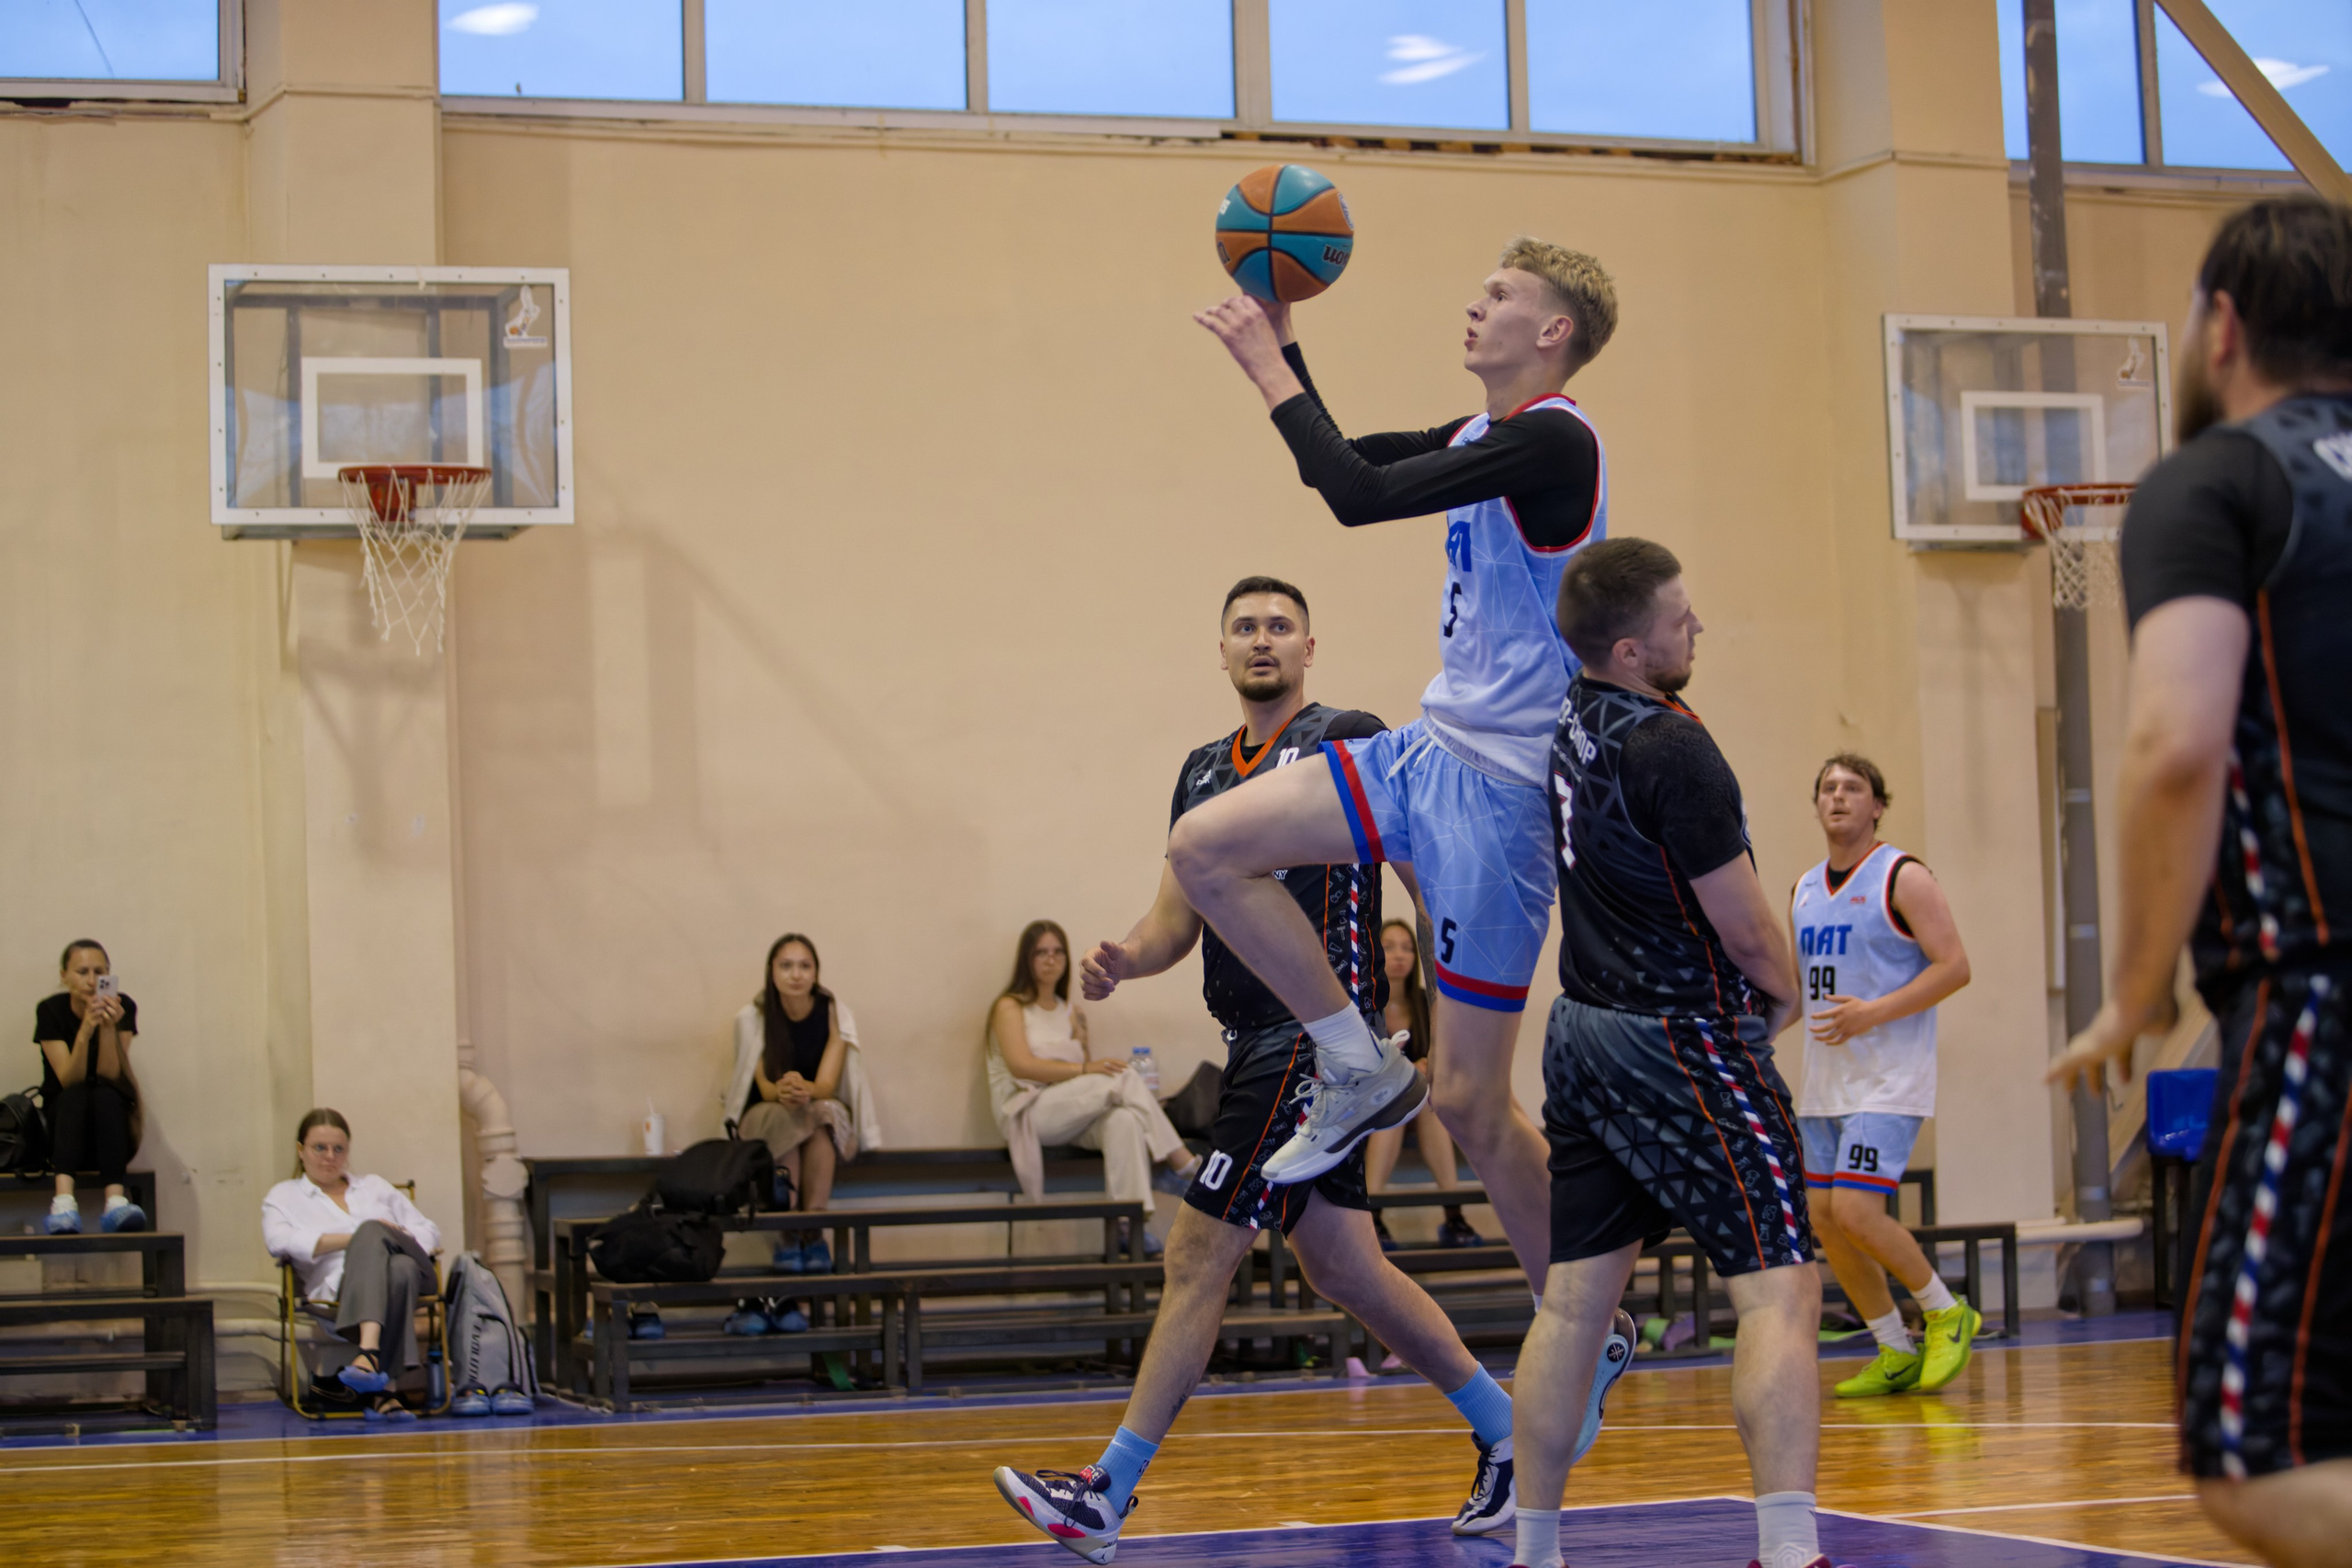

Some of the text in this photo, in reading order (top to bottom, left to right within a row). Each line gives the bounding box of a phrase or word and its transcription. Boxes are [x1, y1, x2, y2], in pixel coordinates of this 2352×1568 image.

[1441, 917, 1456, 964] 5
[1810, 965, 1836, 1000] 99
[1199, 1149, 1233, 1190] 10
[1848, 1144, 1878, 1172] 99
